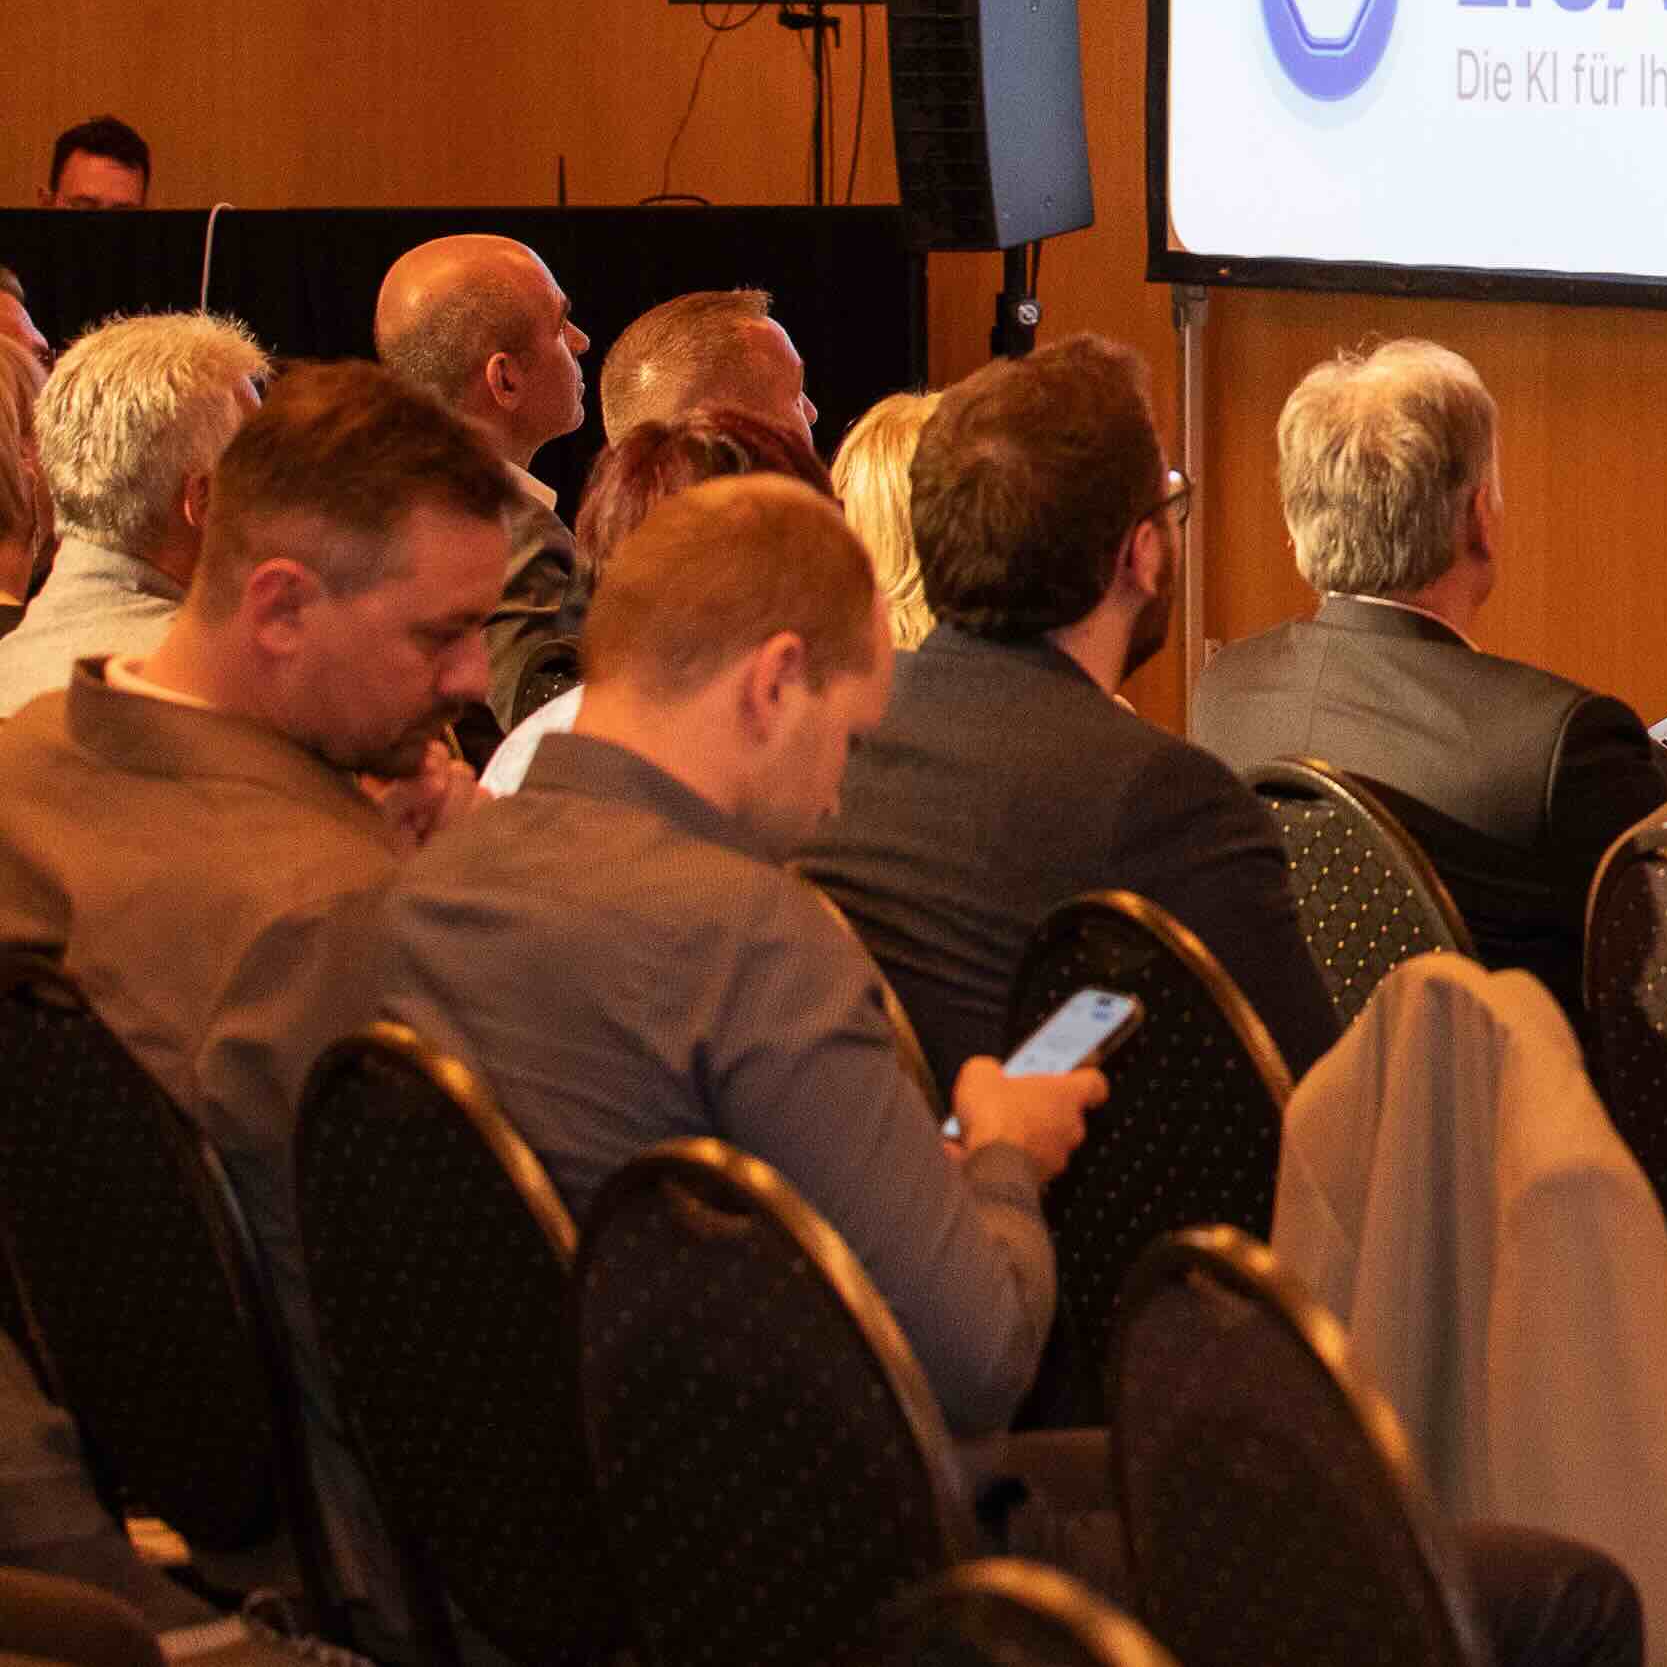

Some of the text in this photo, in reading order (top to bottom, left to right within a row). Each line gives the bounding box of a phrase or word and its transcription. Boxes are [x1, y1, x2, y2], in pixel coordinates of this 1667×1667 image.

[1456, 47, 1513, 103] Die
[1526, 50, 1559, 105] KI
[1572, 51, 1626, 107] für
